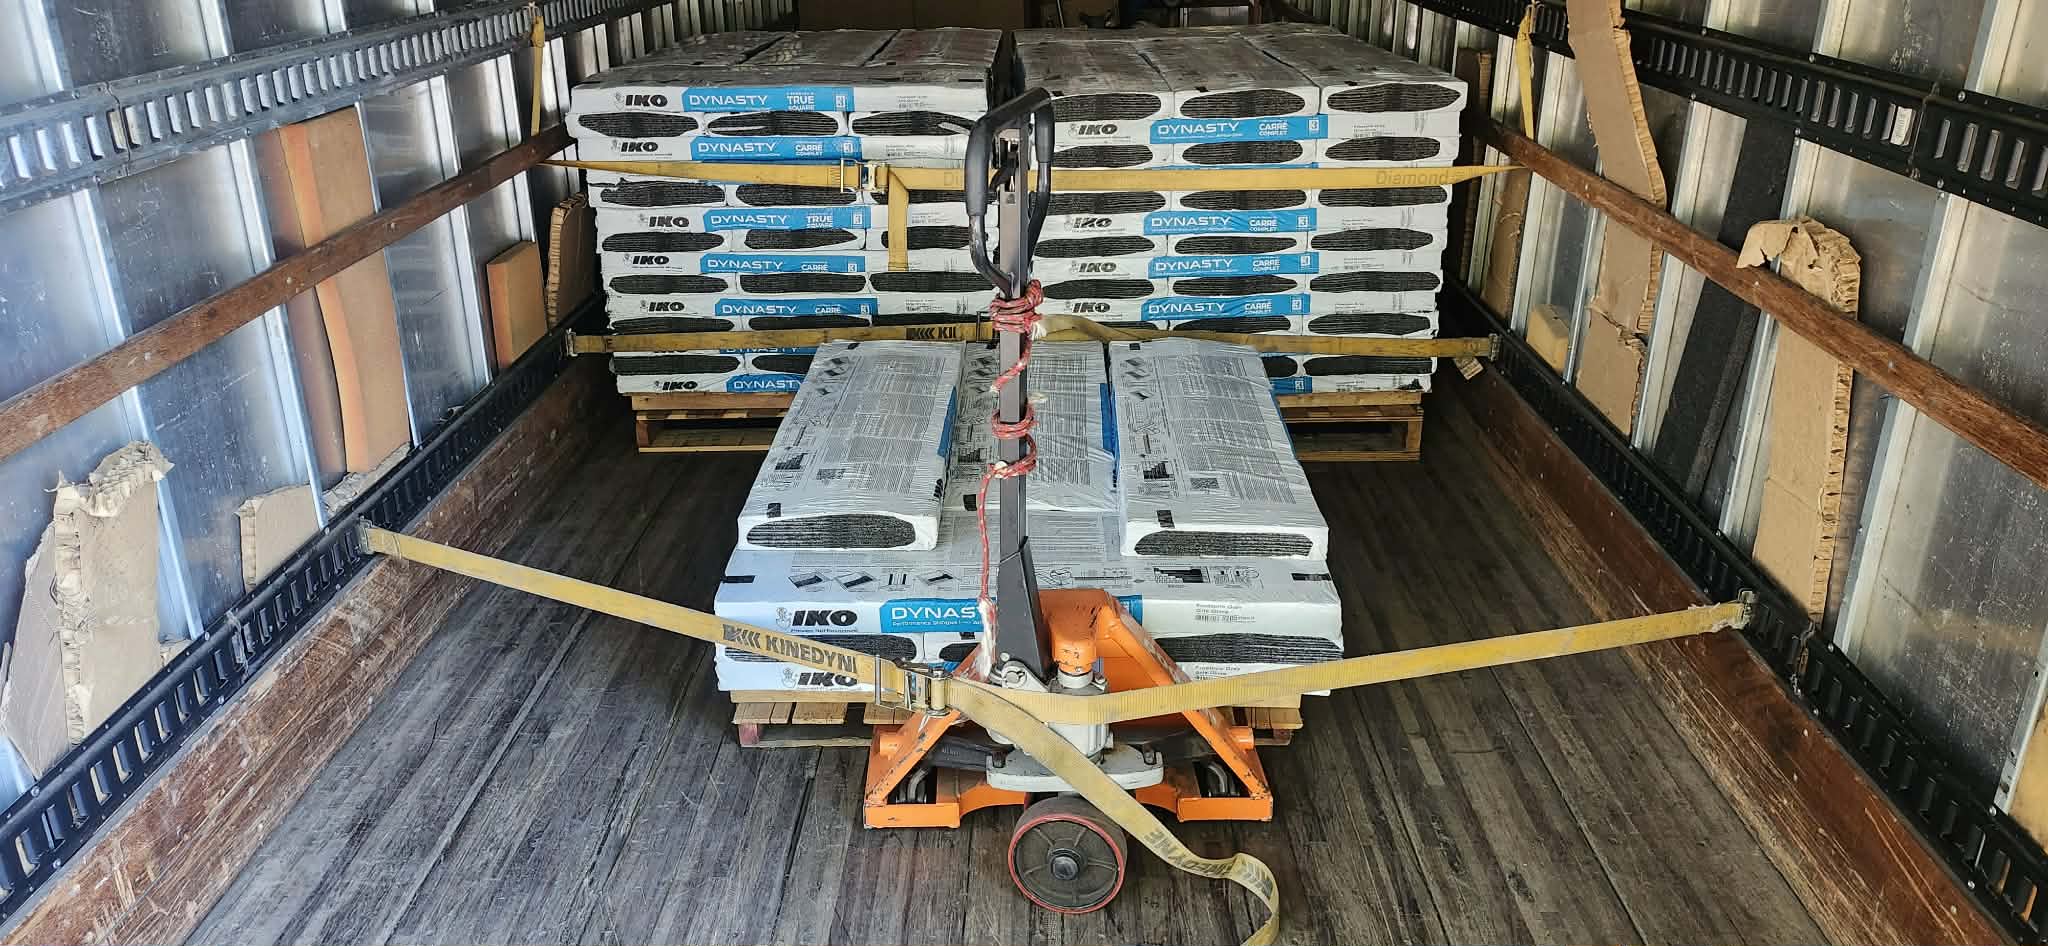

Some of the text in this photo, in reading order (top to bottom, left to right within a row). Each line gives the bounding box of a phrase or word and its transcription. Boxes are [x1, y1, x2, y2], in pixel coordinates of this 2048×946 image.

[625, 94, 668, 107] IKO
[689, 95, 768, 105] DYNASTY
[787, 95, 815, 104] TRUE
[1079, 124, 1118, 135] IKO
[1158, 122, 1239, 134] DYNASTY
[621, 141, 659, 152] IKO
[698, 142, 776, 152] DYNASTY
[1377, 169, 1449, 185] Diamond
[649, 216, 689, 227] IKO
[711, 215, 787, 224] DYNASTY
[806, 215, 833, 223] TRUE
[1073, 217, 1112, 228] IKO
[1152, 216, 1232, 227] DYNASTY
[633, 255, 669, 265] IKO
[707, 259, 783, 270] DYNASTY
[1155, 258, 1232, 271] DYNASTY
[1080, 262, 1117, 273] IKO
[649, 302, 685, 312] IKO
[722, 304, 797, 314] DYNASTY
[1073, 302, 1110, 312] IKO
[1148, 302, 1225, 314] DYNASTY
[662, 380, 698, 390] IKO
[792, 610, 858, 626] IKO
[891, 607, 980, 619] DYNAS
[798, 672, 858, 687] IKO
